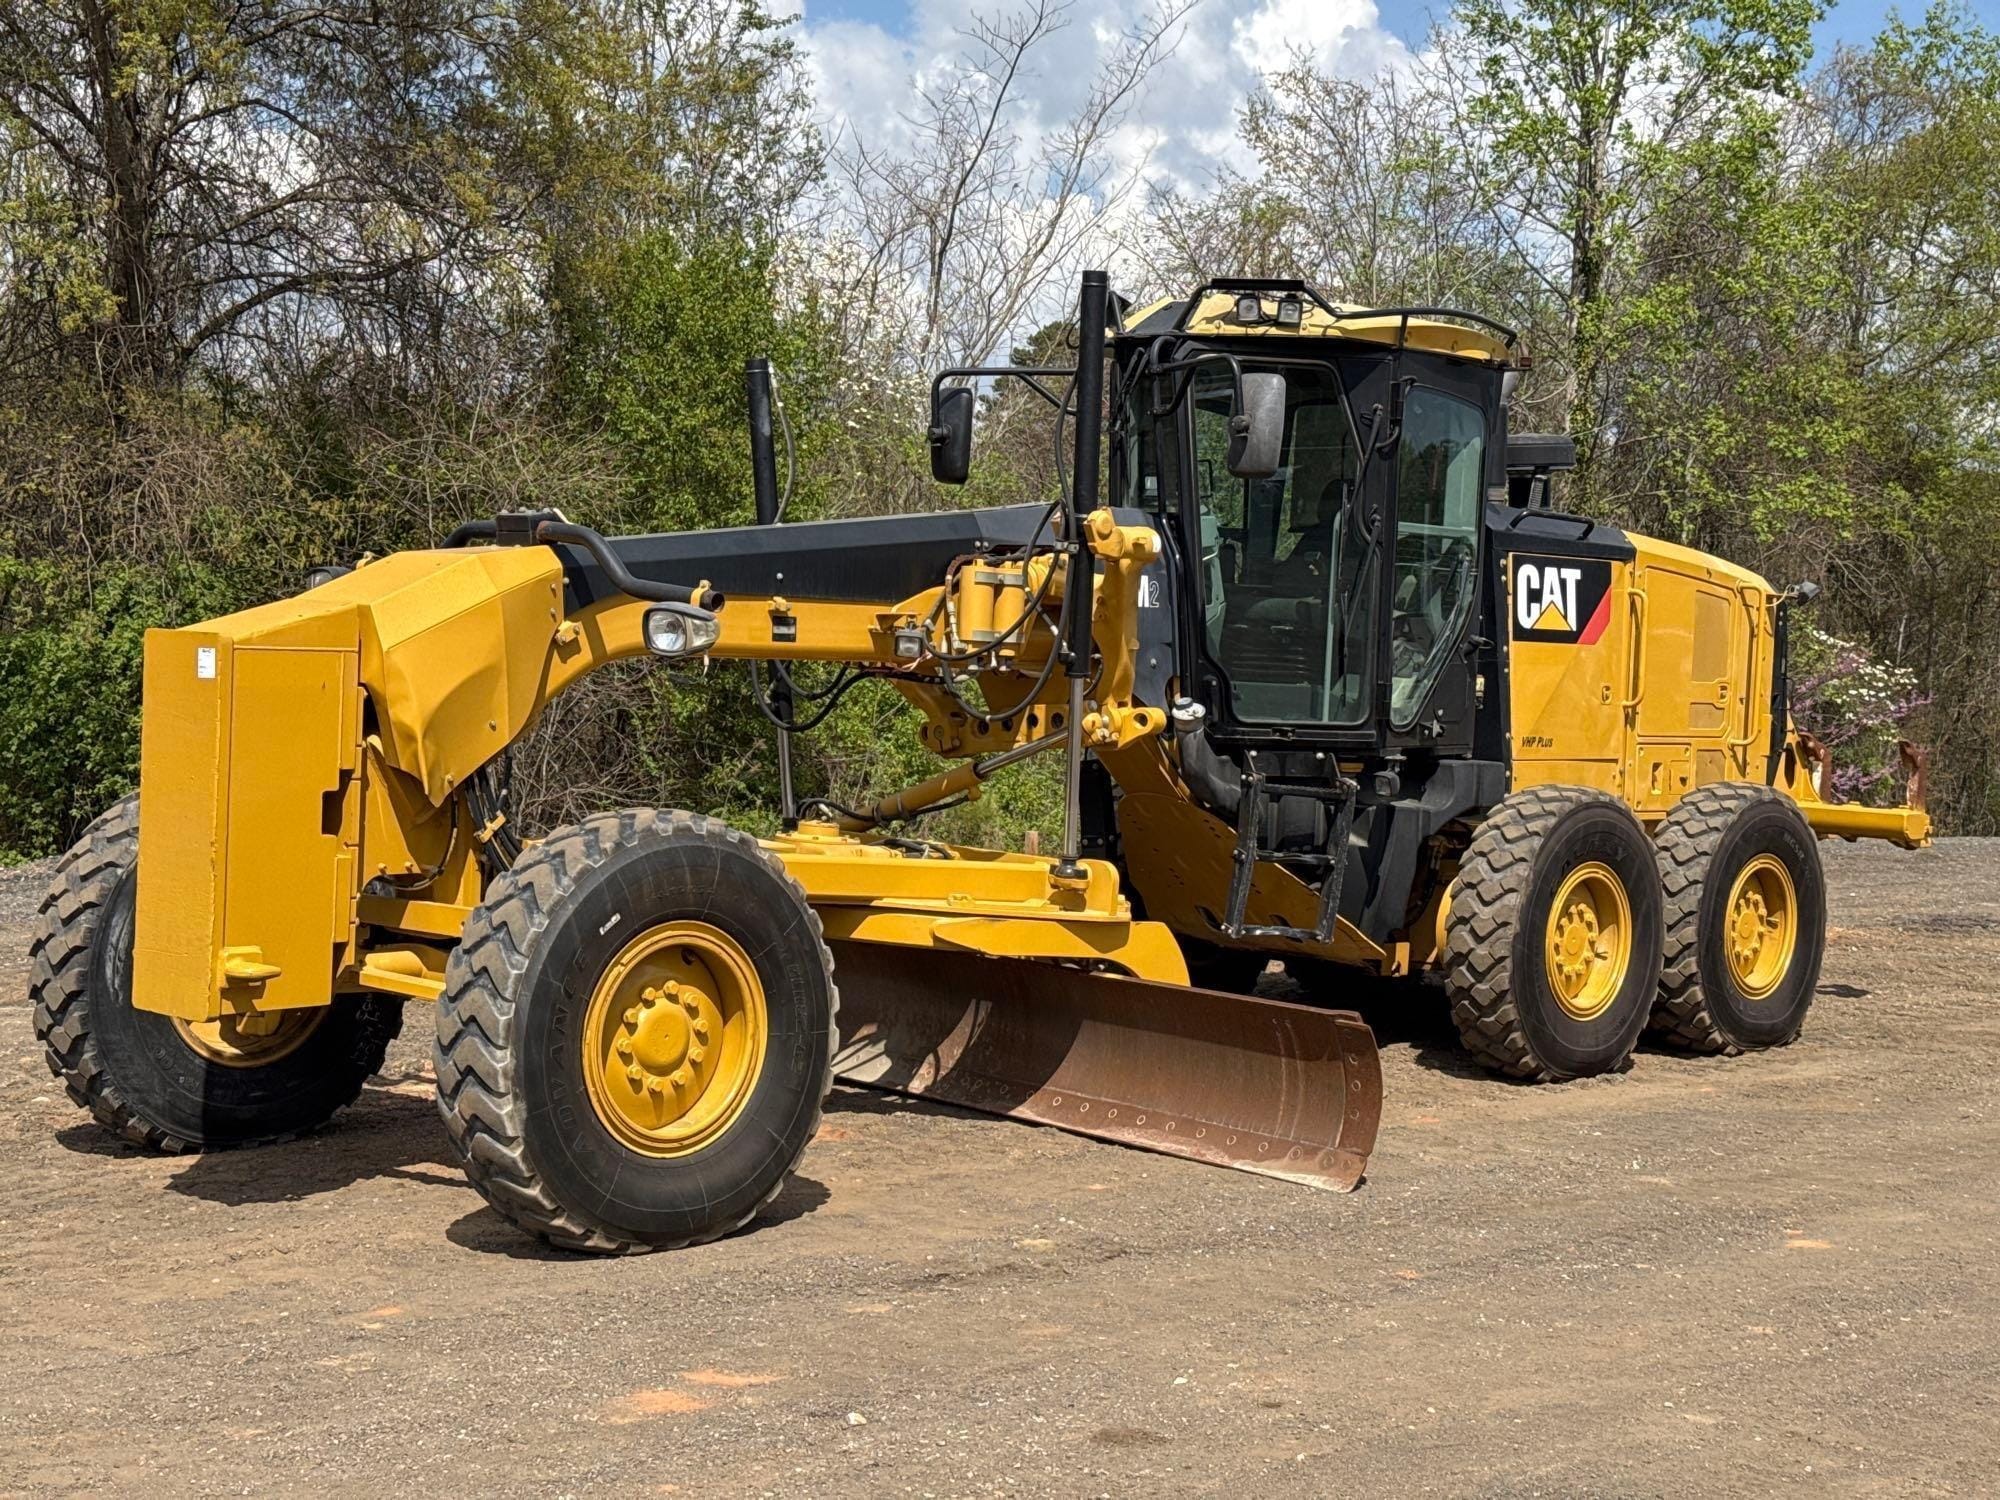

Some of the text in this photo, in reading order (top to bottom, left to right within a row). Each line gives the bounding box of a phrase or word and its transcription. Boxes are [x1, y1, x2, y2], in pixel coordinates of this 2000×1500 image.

[1517, 564, 1581, 631] CAT
[1521, 736, 1554, 748] VHP PLUS
[550, 946, 590, 1152] ADVANCE
